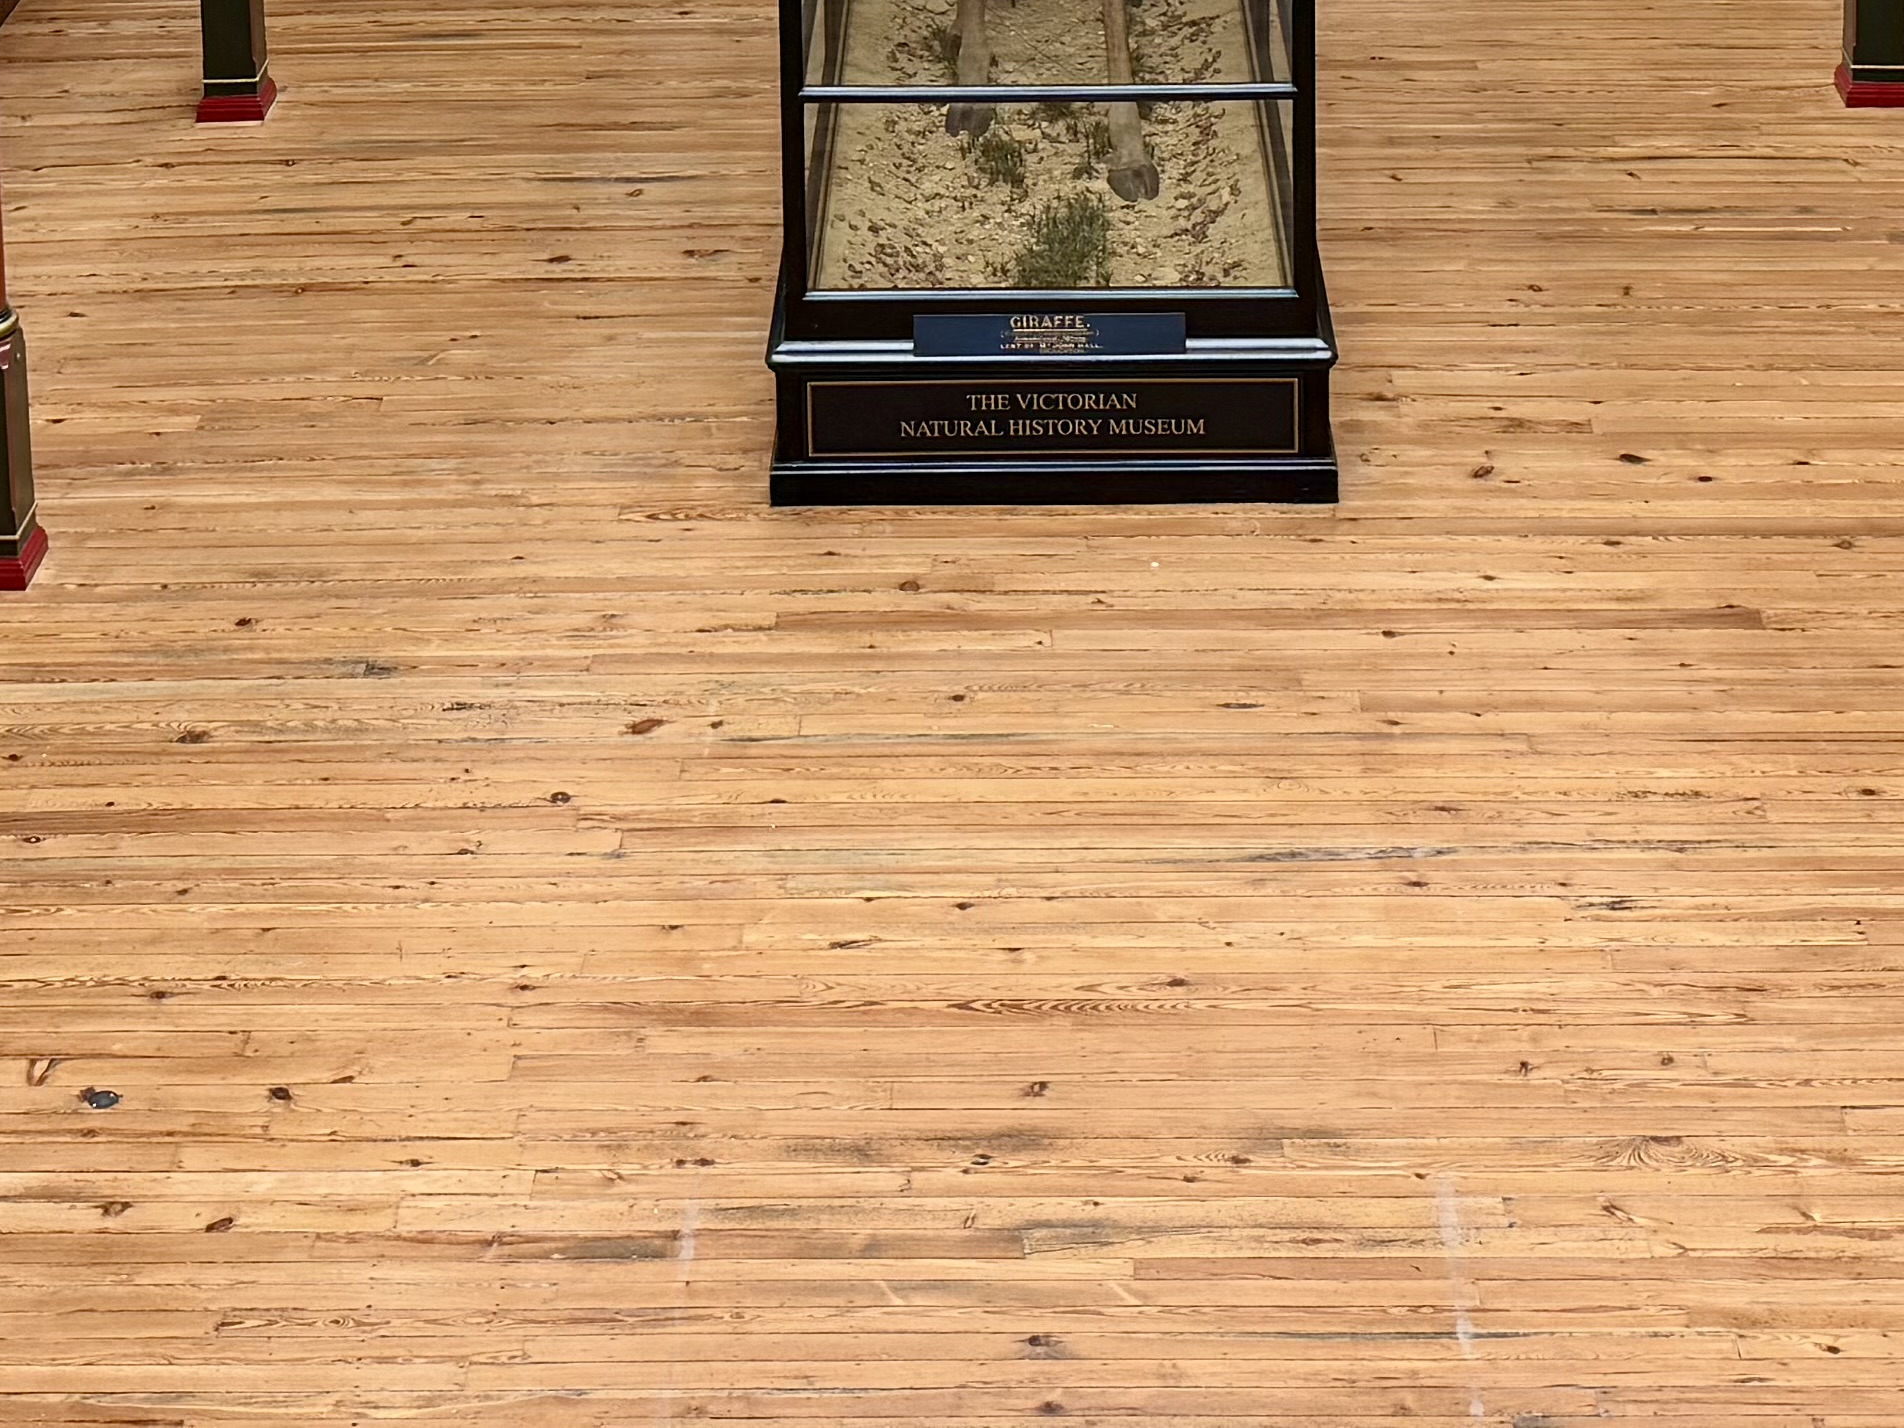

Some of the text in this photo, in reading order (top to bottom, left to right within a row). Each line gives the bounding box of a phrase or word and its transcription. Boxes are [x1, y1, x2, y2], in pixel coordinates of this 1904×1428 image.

[1010, 315, 1091, 329] GIRAFFE.
[966, 393, 1137, 411] THE VICTORIAN
[900, 418, 1206, 437] NATURAL HISTORY MUSEUM
